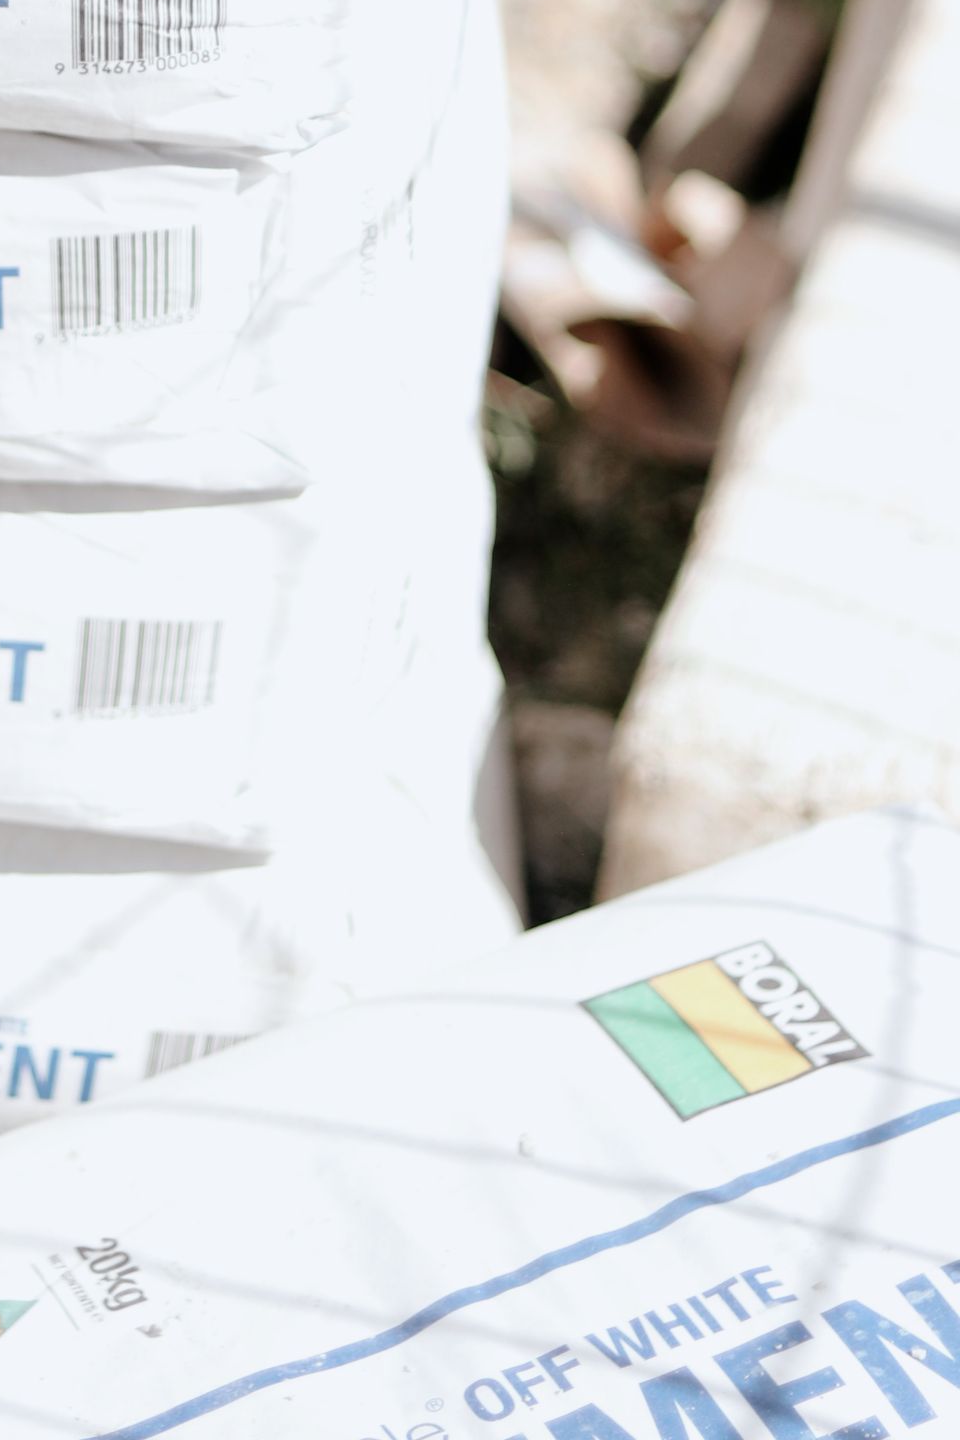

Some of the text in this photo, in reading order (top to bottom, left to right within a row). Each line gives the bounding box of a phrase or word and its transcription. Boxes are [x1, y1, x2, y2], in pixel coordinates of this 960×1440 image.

[54, 63, 66, 75] 9
[78, 60, 148, 75] 314673
[714, 939, 858, 1068] BORAL
[74, 1236, 149, 1312] 20kg
[462, 1344, 583, 1425] OFF
[583, 1264, 799, 1370] WHITE
